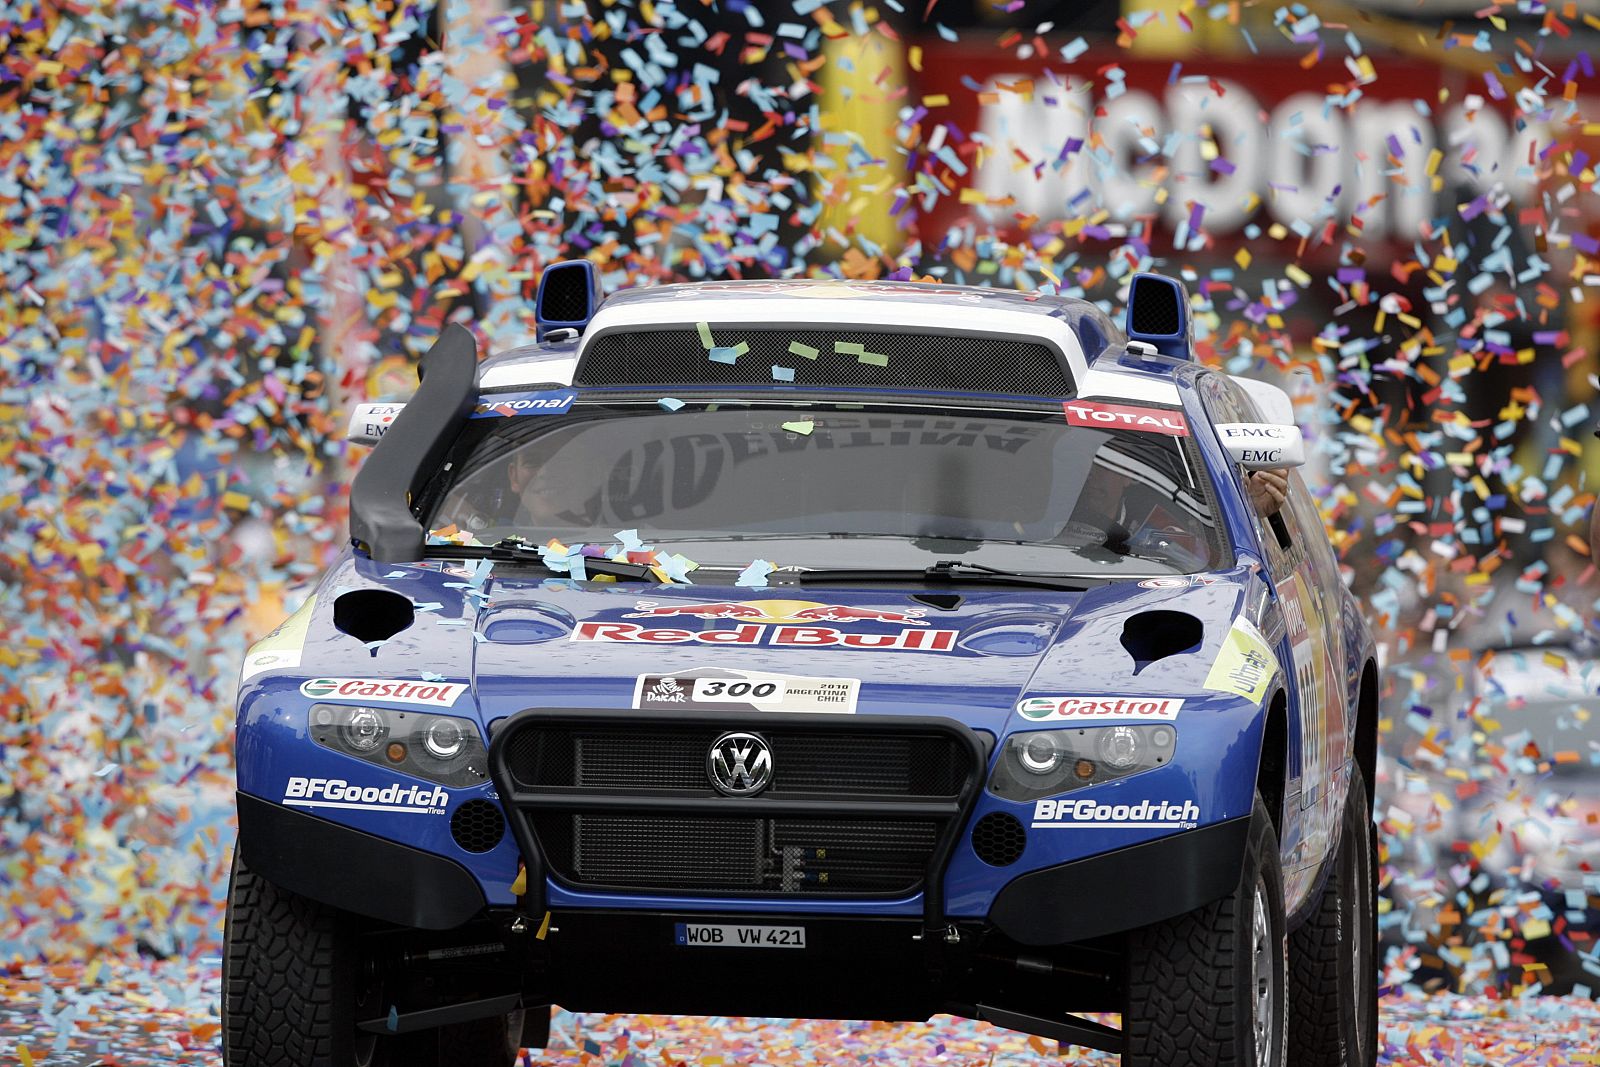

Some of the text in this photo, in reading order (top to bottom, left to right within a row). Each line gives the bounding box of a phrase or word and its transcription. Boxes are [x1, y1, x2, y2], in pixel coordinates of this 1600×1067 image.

[1067, 405, 1185, 430] TOTAL
[570, 621, 960, 651] Red Bull
[338, 681, 454, 701] Castrol
[646, 693, 686, 703] DAKAR
[702, 682, 777, 698] 300
[786, 689, 847, 697] ARGENTINA
[1058, 699, 1171, 716] Castrol
[284, 777, 449, 807] BFGoodrich
[427, 806, 446, 815] Tires
[1033, 799, 1200, 822] BFGoodrich
[1179, 821, 1198, 830] Tires
[687, 927, 804, 945] WOB VW 421
